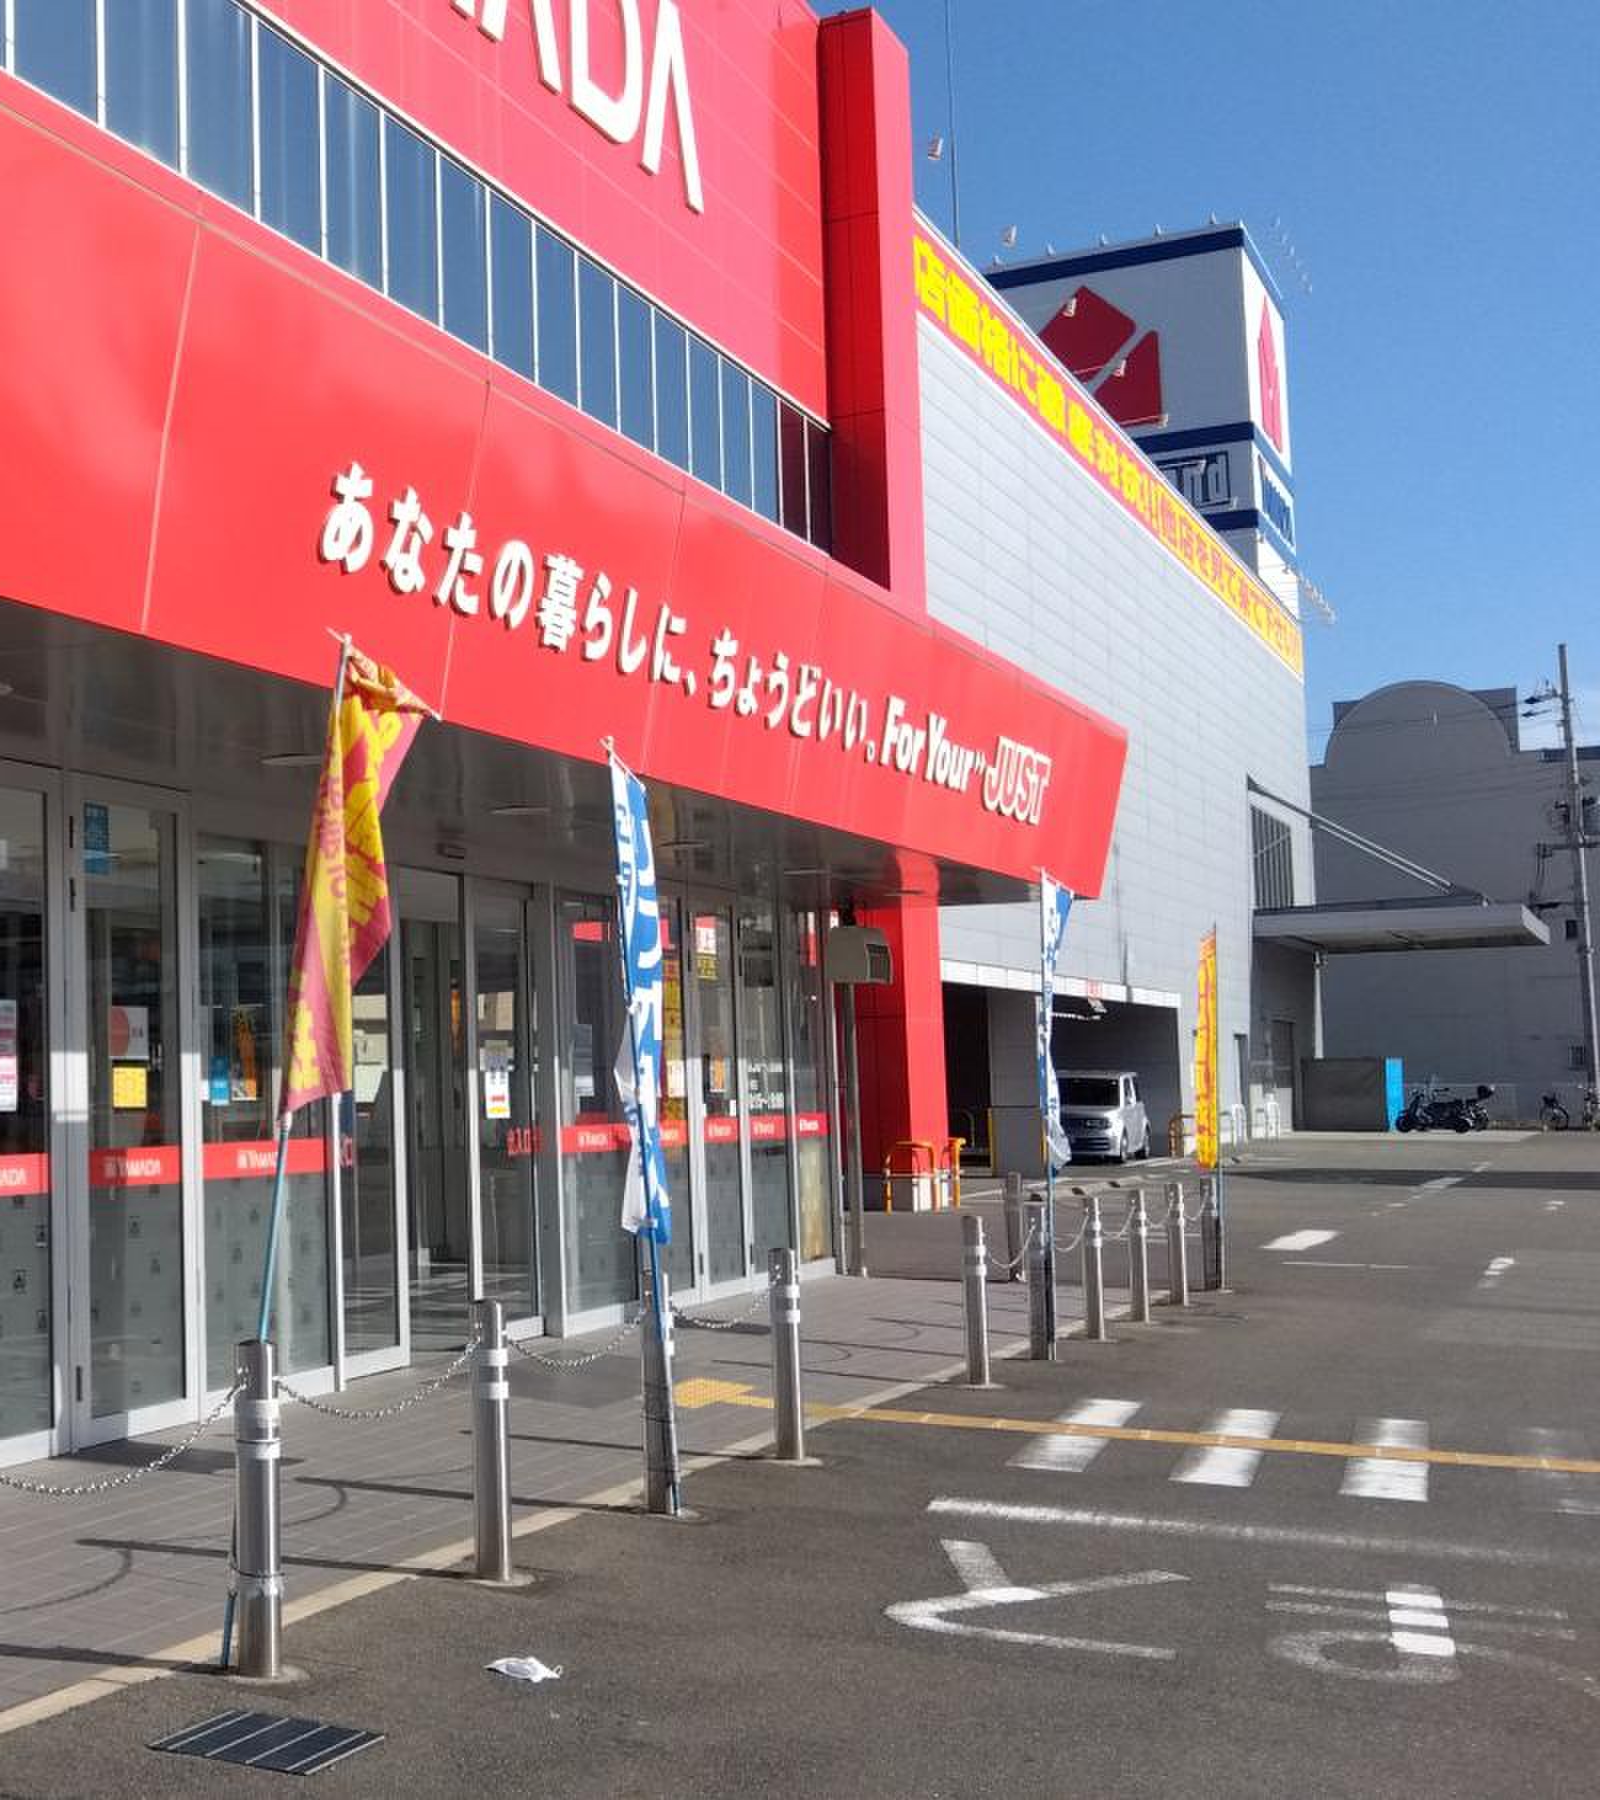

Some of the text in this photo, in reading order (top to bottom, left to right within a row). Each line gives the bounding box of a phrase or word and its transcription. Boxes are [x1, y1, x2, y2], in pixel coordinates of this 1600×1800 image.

[449, 0, 704, 214] DA
[320, 460, 876, 763] あなたの暮らしに、ちょうどいい。
[880, 695, 927, 775] For
[925, 711, 975, 792] Your
